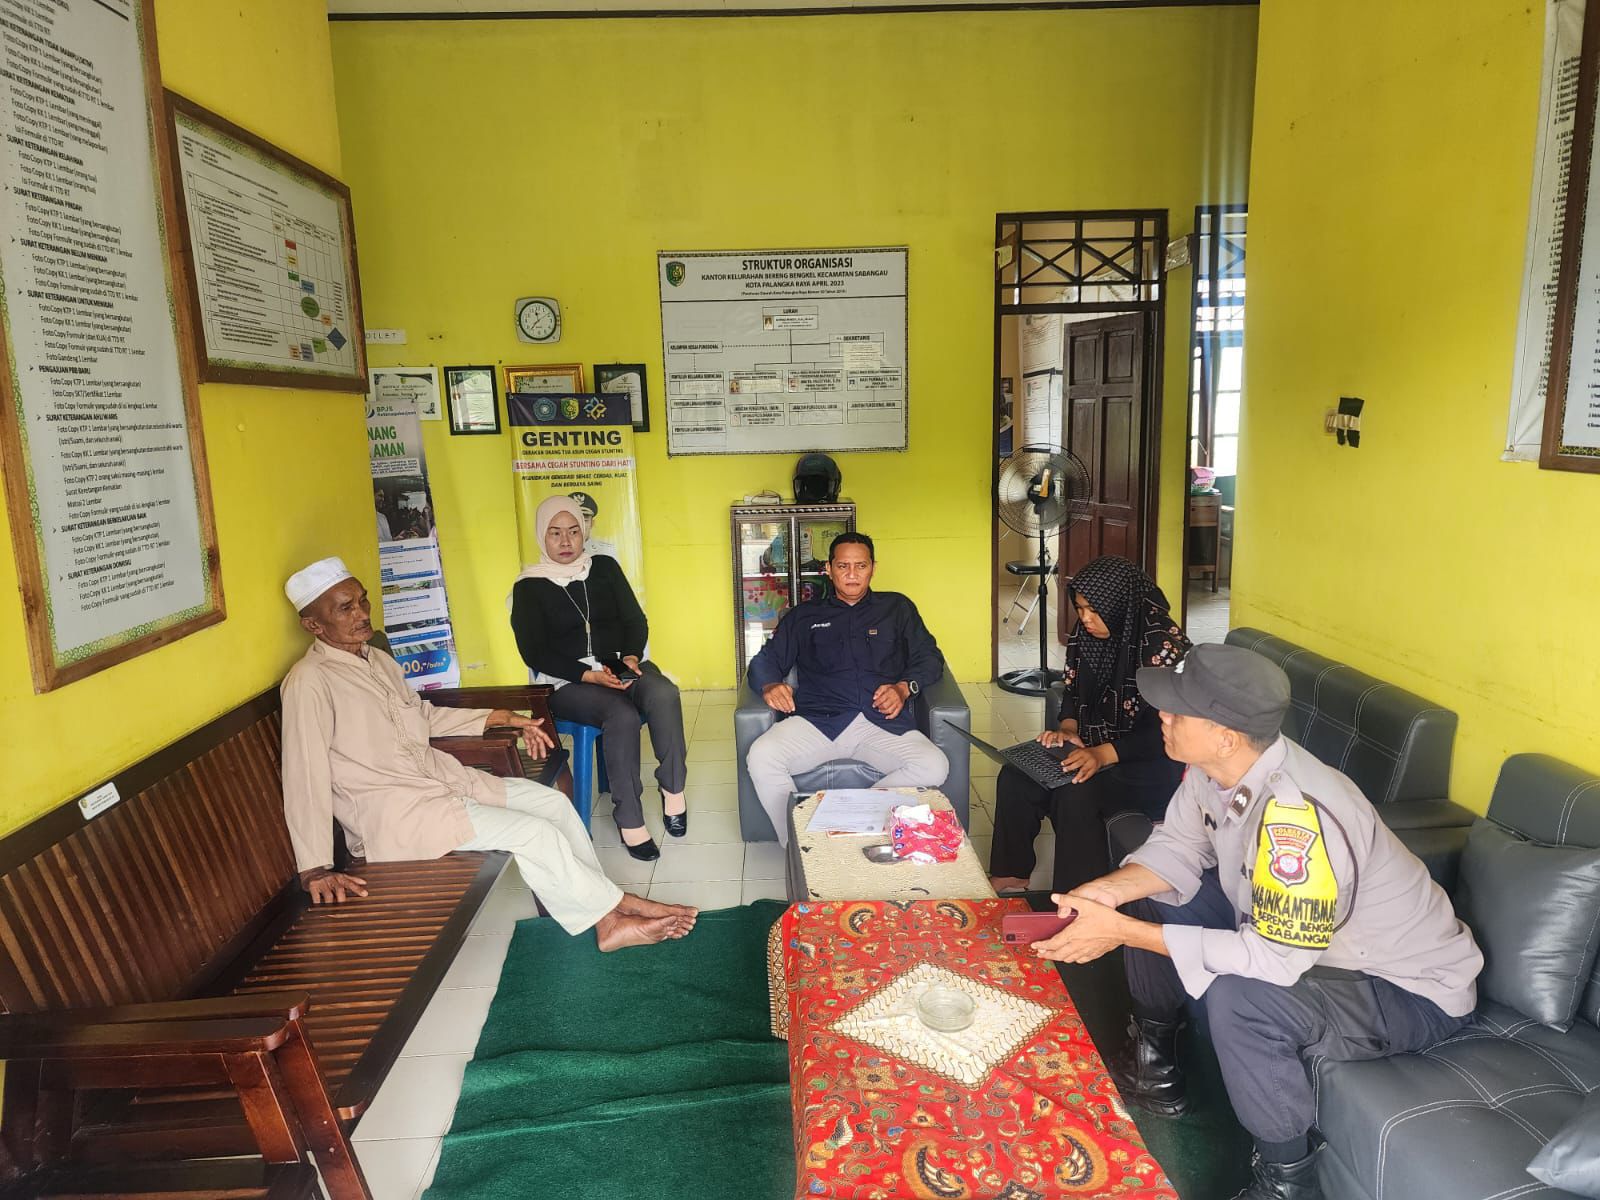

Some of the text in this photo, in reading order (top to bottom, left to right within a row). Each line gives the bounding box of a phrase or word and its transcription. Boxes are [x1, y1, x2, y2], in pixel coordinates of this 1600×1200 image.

[6, 134, 23, 146] SURAT
[14, 186, 30, 197] SURAT
[31, 191, 64, 206] KETERANGAN
[20, 238, 37, 249] SURAT
[38, 241, 70, 255] KETERANGAN
[44, 255, 56, 266] Copy
[742, 258, 853, 270] STRUKTUR ORGANISASI
[28, 289, 44, 299] SURAT
[45, 292, 76, 304] KETERANGAN
[364, 332, 397, 340] OILET
[46, 353, 58, 361] Foto
[39, 365, 68, 373] PENGAJUAN
[50, 378, 61, 386] Foto
[62, 378, 72, 387] Copy
[73, 378, 82, 386] KTP
[63, 390, 74, 399] Copy
[65, 402, 76, 411] Copy
[368, 426, 396, 441] NANG
[522, 430, 622, 446] GENTING
[374, 442, 406, 458] AMAN
[516, 462, 546, 470] BERSAMA
[548, 461, 568, 469] CEGAH
[570, 460, 600, 468] STUNTING
[602, 460, 616, 468] DARI
[75, 475, 85, 485] Copy
[61, 522, 76, 532] SURAT
[78, 518, 106, 530] KETERANGAN
[68, 569, 82, 580] SURAT
[84, 563, 112, 577] KETERANGAN
[1258, 911, 1294, 929] BERENG
